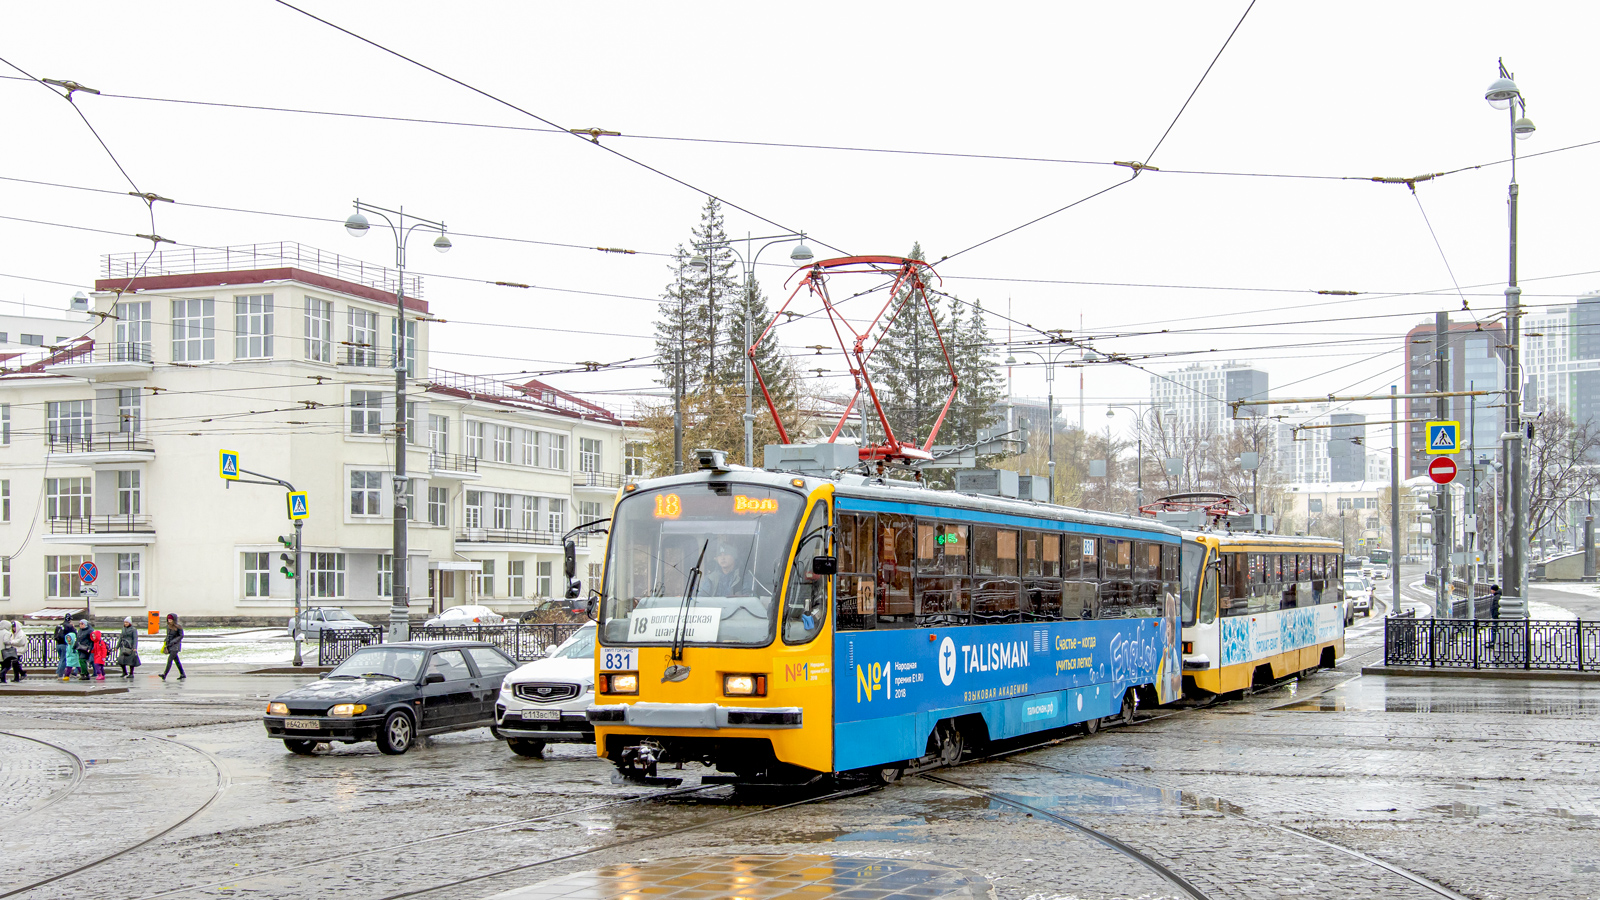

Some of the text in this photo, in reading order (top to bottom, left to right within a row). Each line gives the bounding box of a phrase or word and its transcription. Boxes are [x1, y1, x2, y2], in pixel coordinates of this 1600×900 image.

[655, 493, 681, 518] 18
[1084, 540, 1093, 554] 831
[634, 617, 648, 634] 18
[1055, 635, 1077, 651] Счастье
[1082, 636, 1096, 649] когда
[606, 653, 630, 669] 831
[961, 640, 1028, 674] TALISMAN
[1055, 653, 1093, 676] учиться легко!
[1110, 626, 1157, 699] English
[894, 661, 917, 672] Народная
[894, 673, 924, 686] премия E1.RU
[894, 689, 907, 698] 2018
[963, 683, 1028, 702] ЯЗЫКОВАЯ АКАДЕМИЯ
[1027, 701, 1054, 715] талисман.рф
